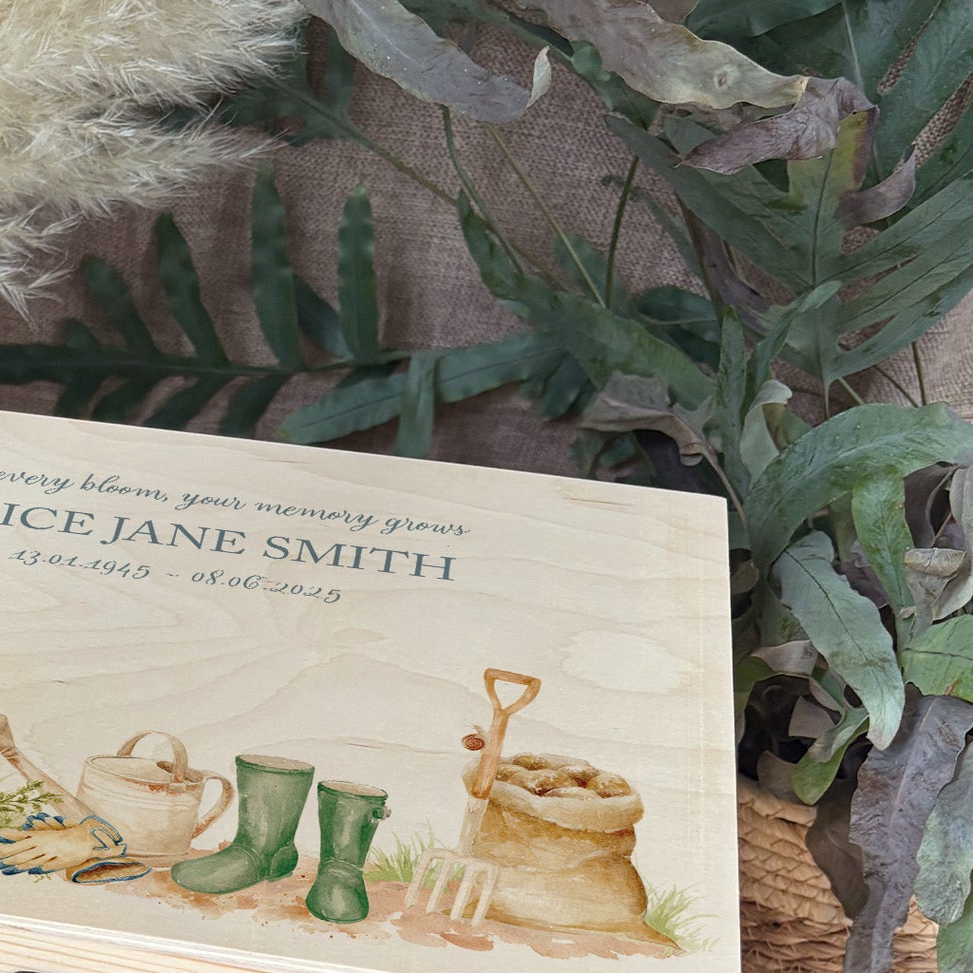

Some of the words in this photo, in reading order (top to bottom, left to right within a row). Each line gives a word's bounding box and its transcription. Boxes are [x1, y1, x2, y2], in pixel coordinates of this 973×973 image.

[80, 473, 169, 503] bloom,
[174, 492, 246, 512] your
[254, 501, 380, 532] memory
[380, 517, 472, 536] grows
[7, 549, 150, 580] 13.01.1945
[192, 569, 342, 604] 08.06.2025
[100, 516, 247, 555] JANE
[263, 535, 457, 582] SMITH
